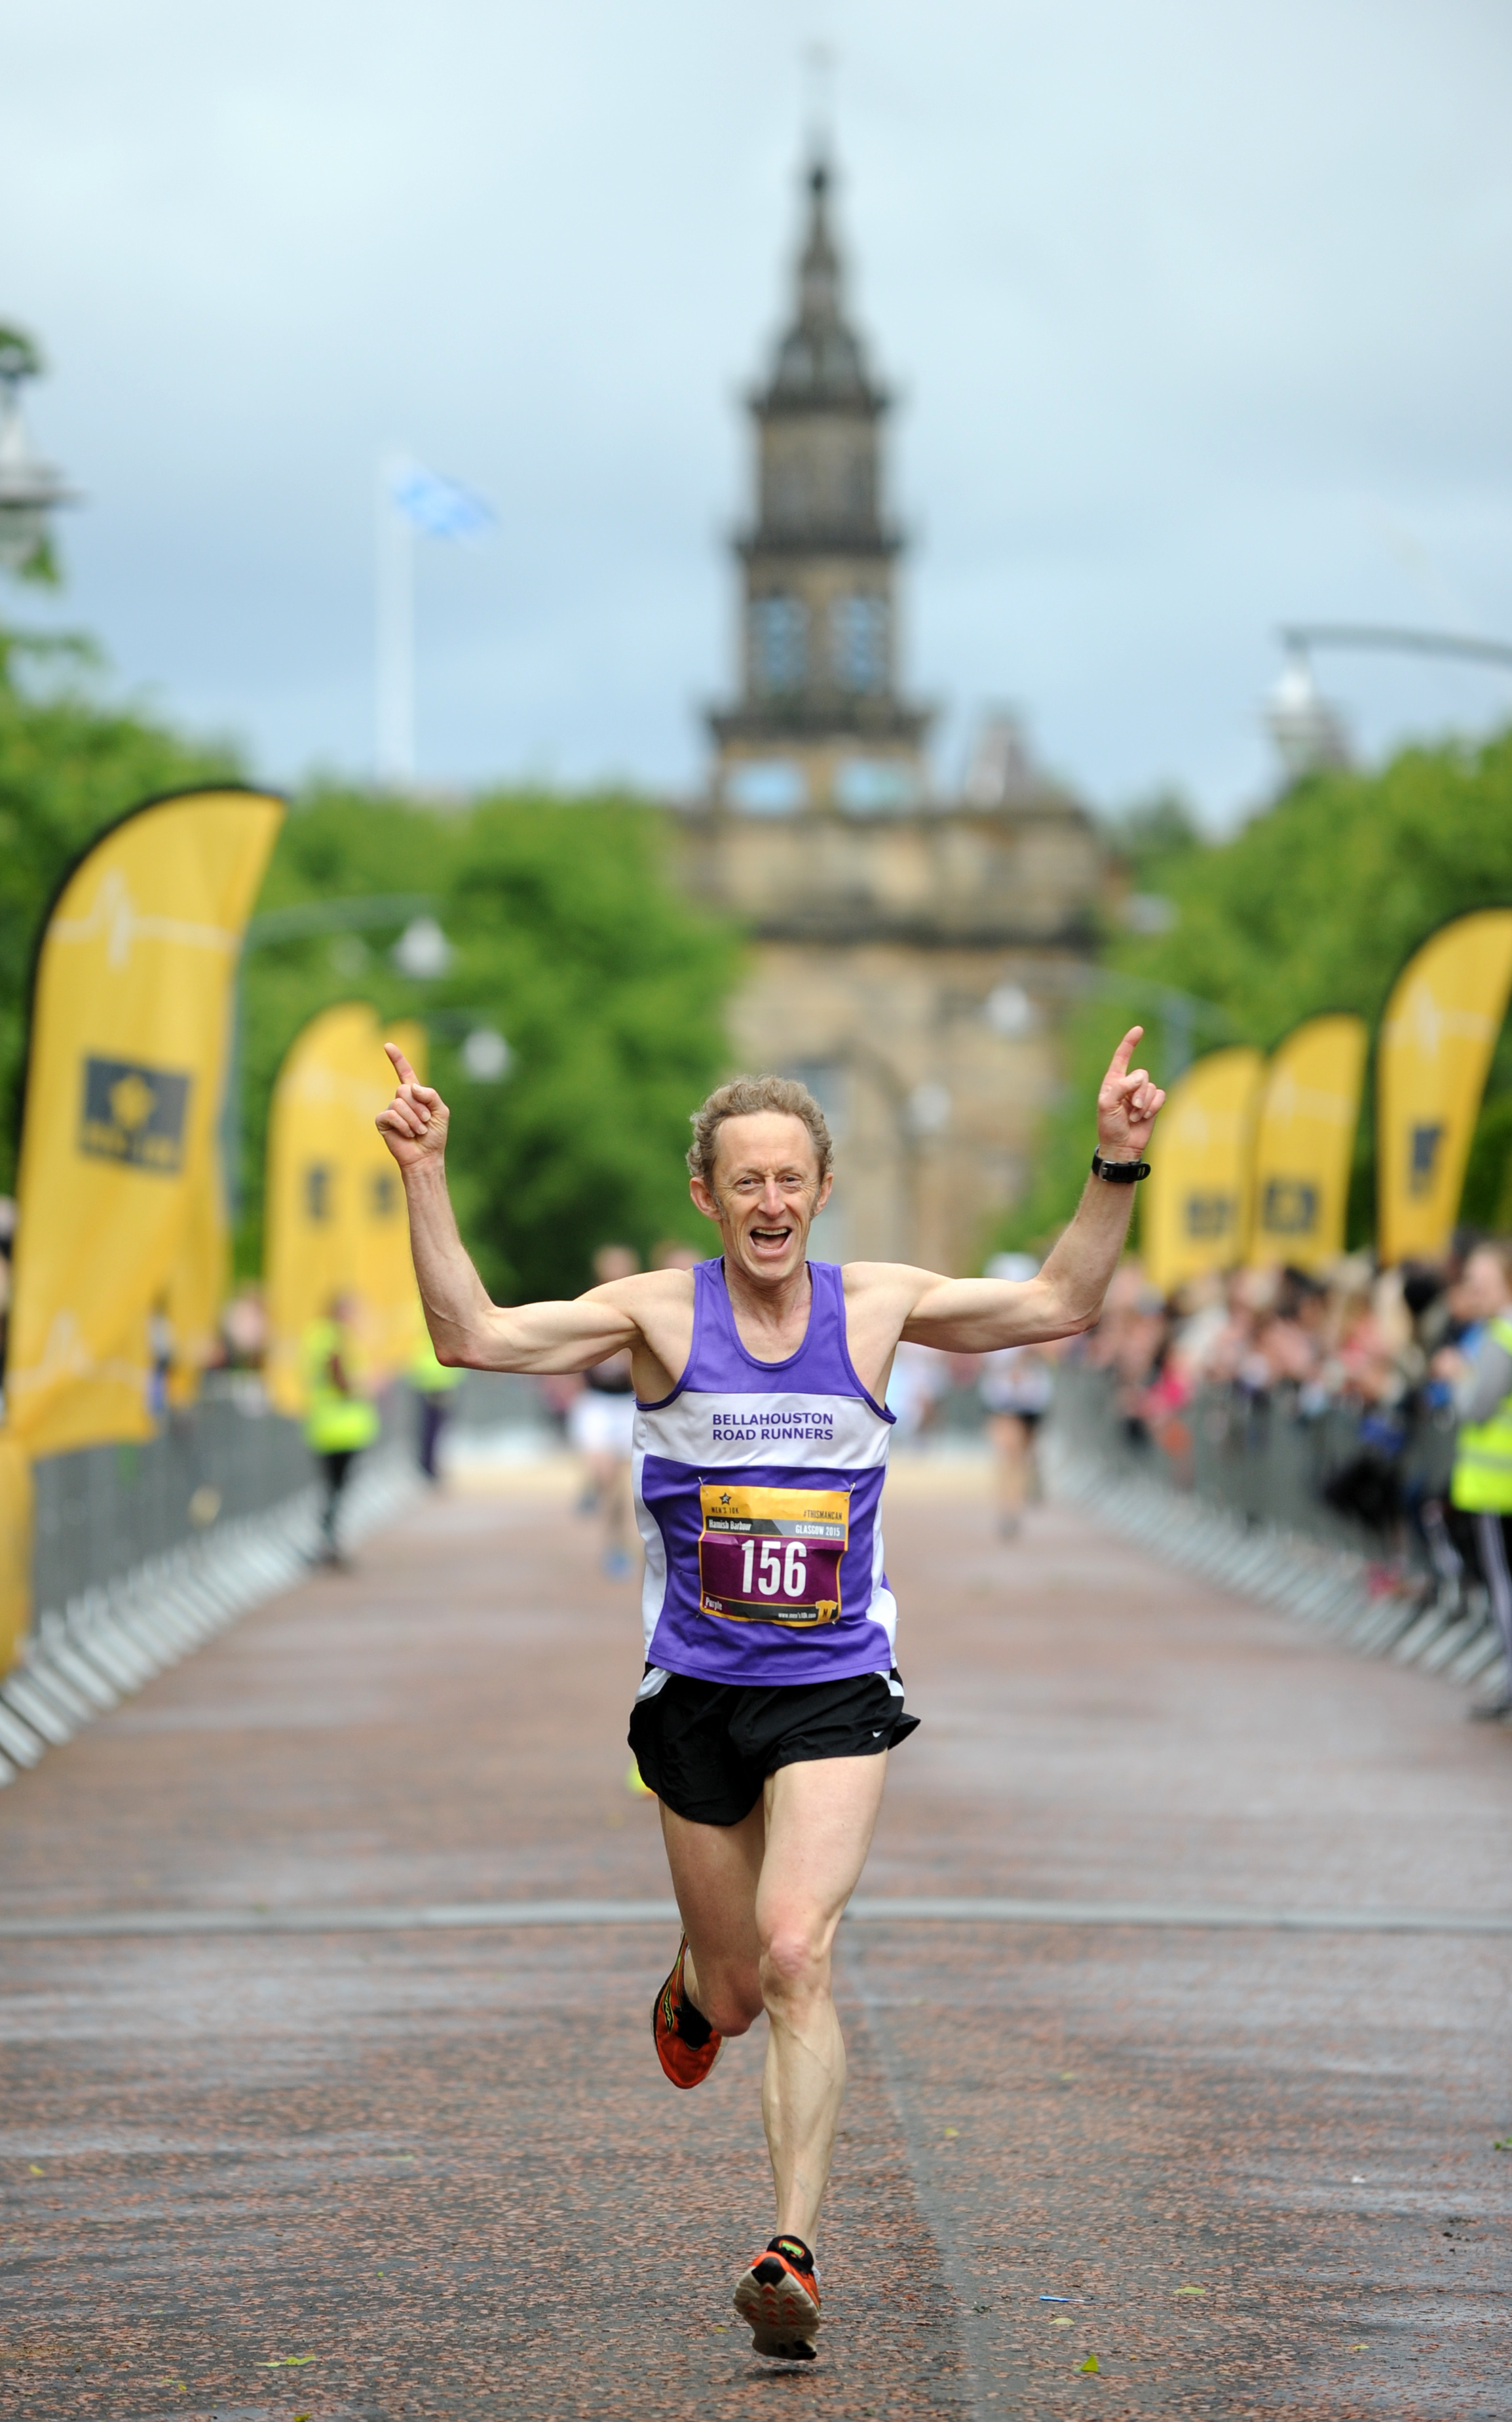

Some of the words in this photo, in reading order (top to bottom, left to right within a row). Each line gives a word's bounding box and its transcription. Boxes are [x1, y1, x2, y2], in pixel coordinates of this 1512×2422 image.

[713, 1413, 833, 1425] BELLAHOUSTON
[713, 1429, 756, 1440] ROAD
[761, 1428, 833, 1440] RUNNERS
[803, 1510, 842, 1520] #THISMANCAN
[709, 1519, 729, 1529] Hamish
[795, 1524, 824, 1535] GLASGOW
[825, 1526, 841, 1537] 2015
[741, 1539, 807, 1597] 156
[706, 1596, 723, 1611] Purple
